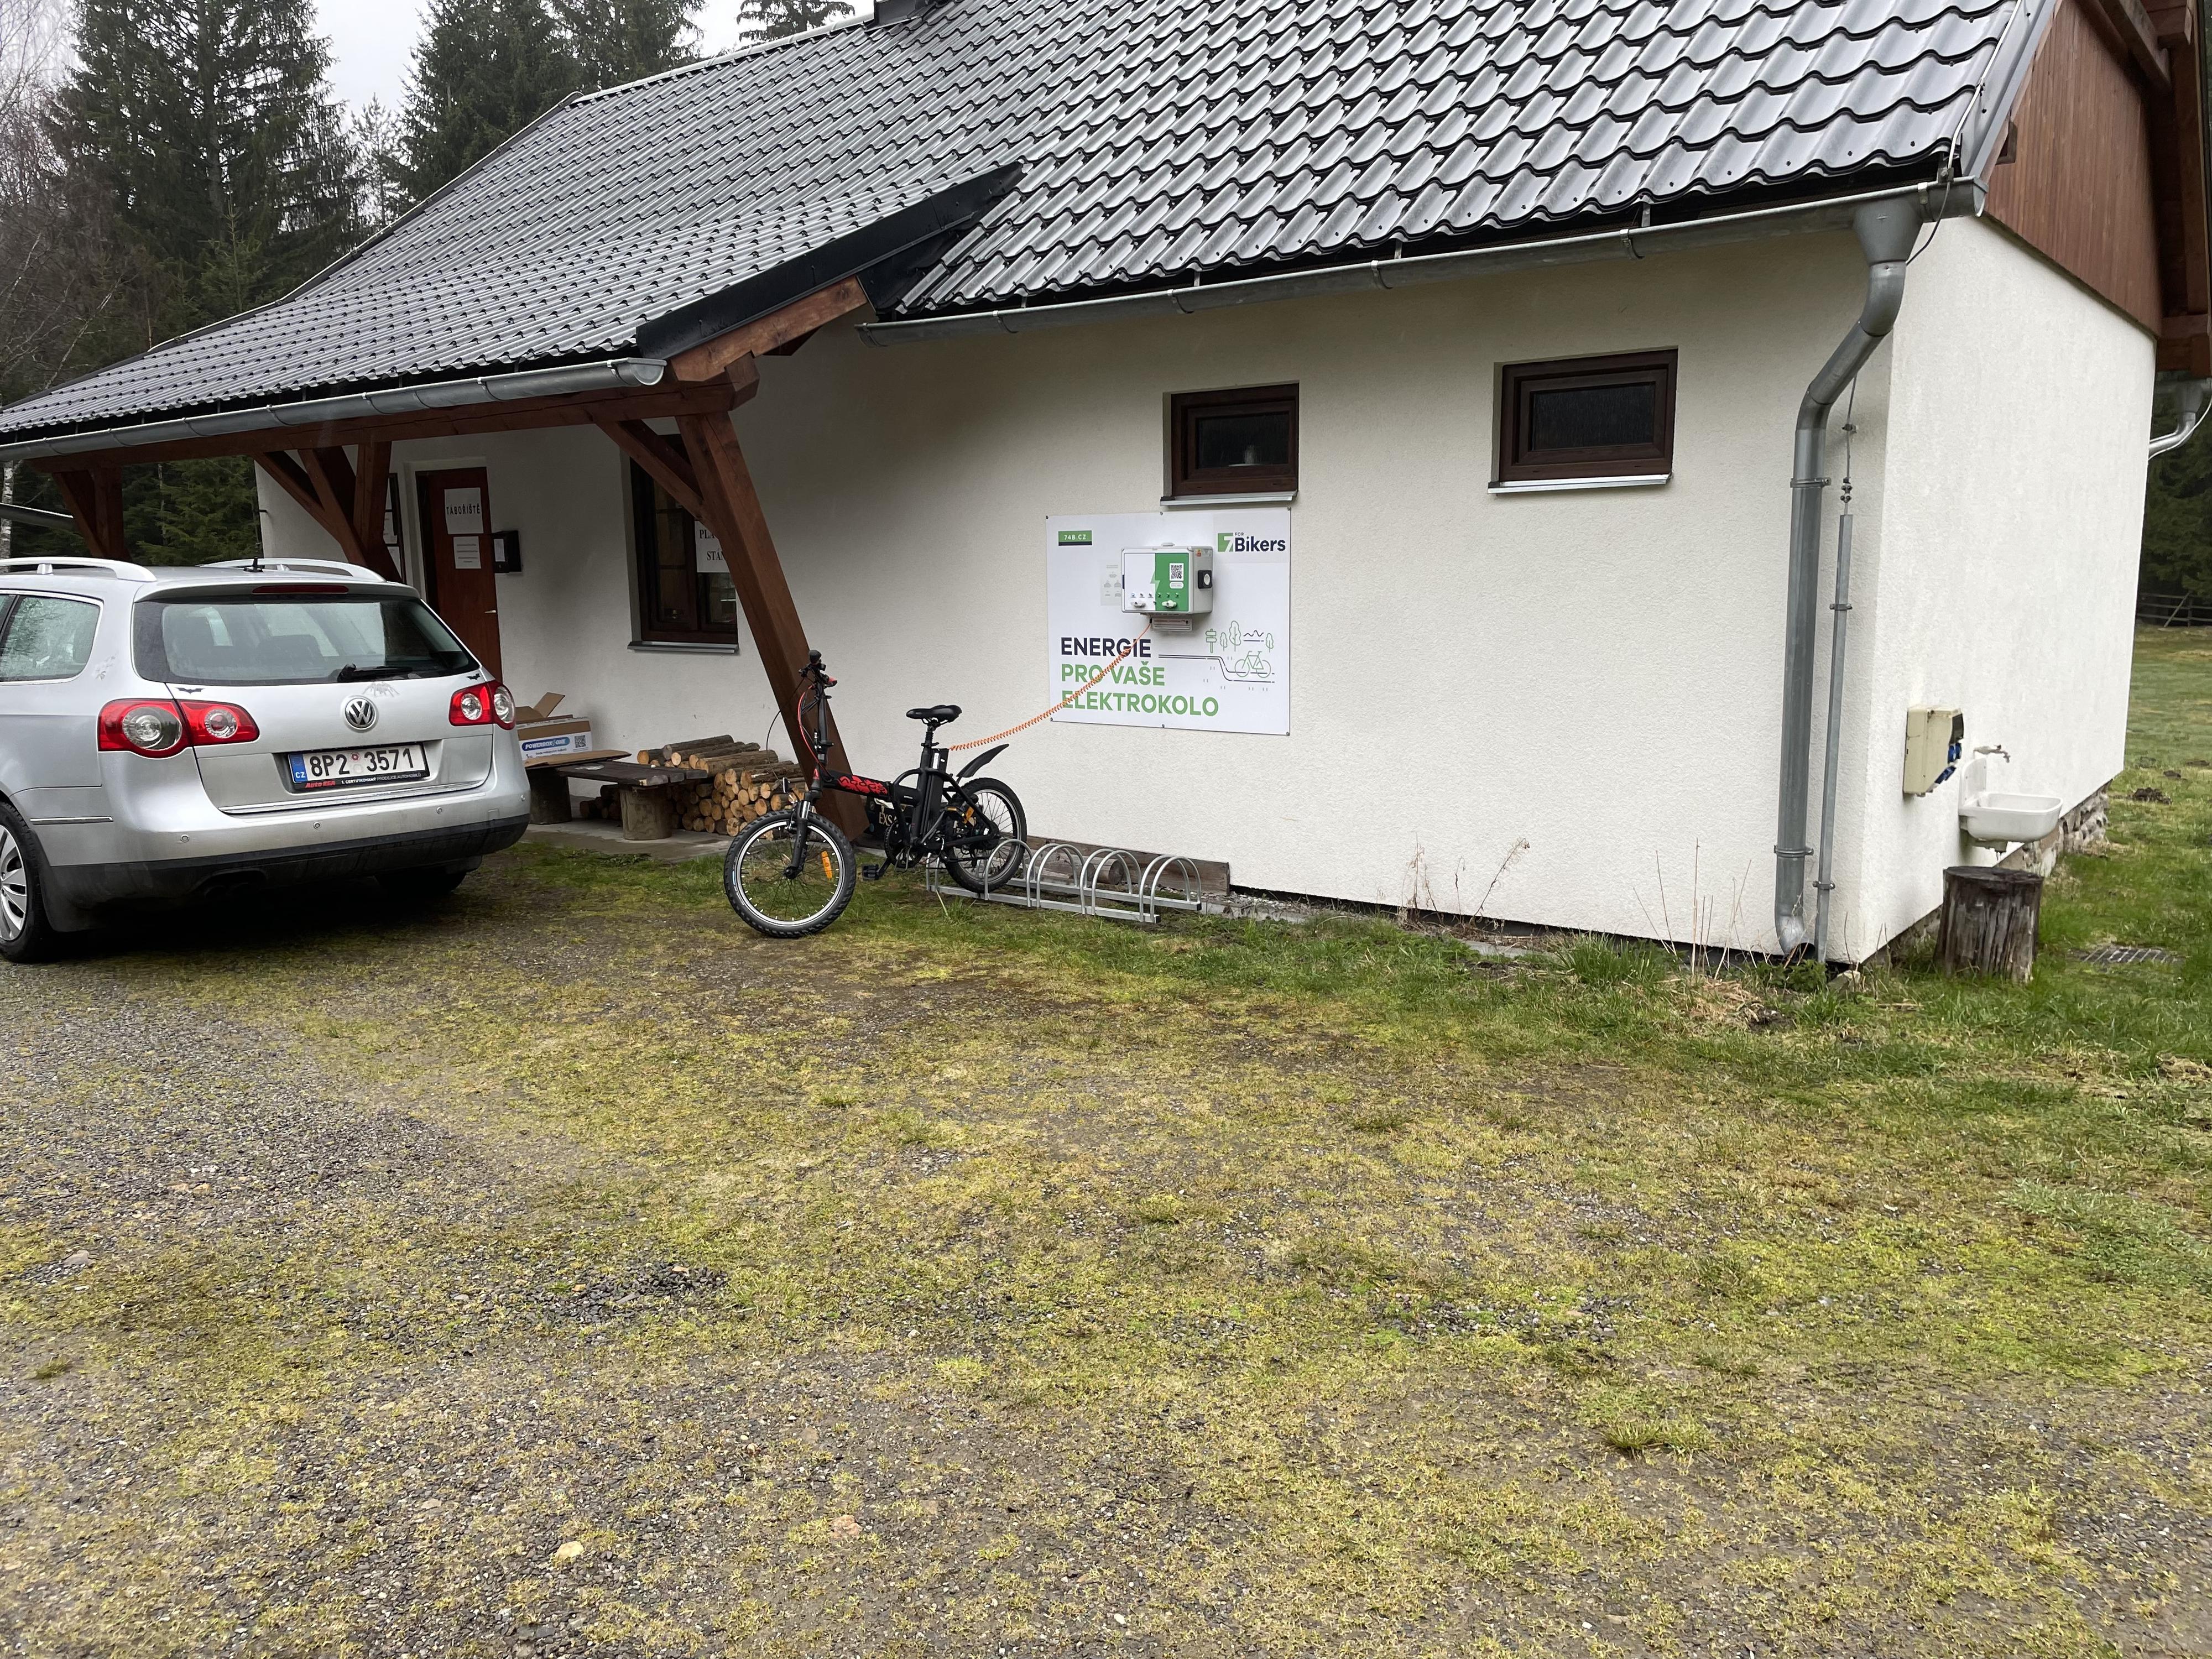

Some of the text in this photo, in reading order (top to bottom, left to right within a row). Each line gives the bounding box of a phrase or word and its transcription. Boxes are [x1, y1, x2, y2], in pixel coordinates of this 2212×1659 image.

[446, 503, 480, 515] TÁBOŘIŠTĚ
[1235, 536, 1286, 552] Bikers
[1061, 637, 1151, 658] ENERGIE
[1062, 661, 1165, 686] PRO VAŠE
[1062, 690, 1219, 717] ELEKTROKOLO
[525, 740, 552, 749] POWERBOX
[310, 748, 414, 777] 8P2 3571
